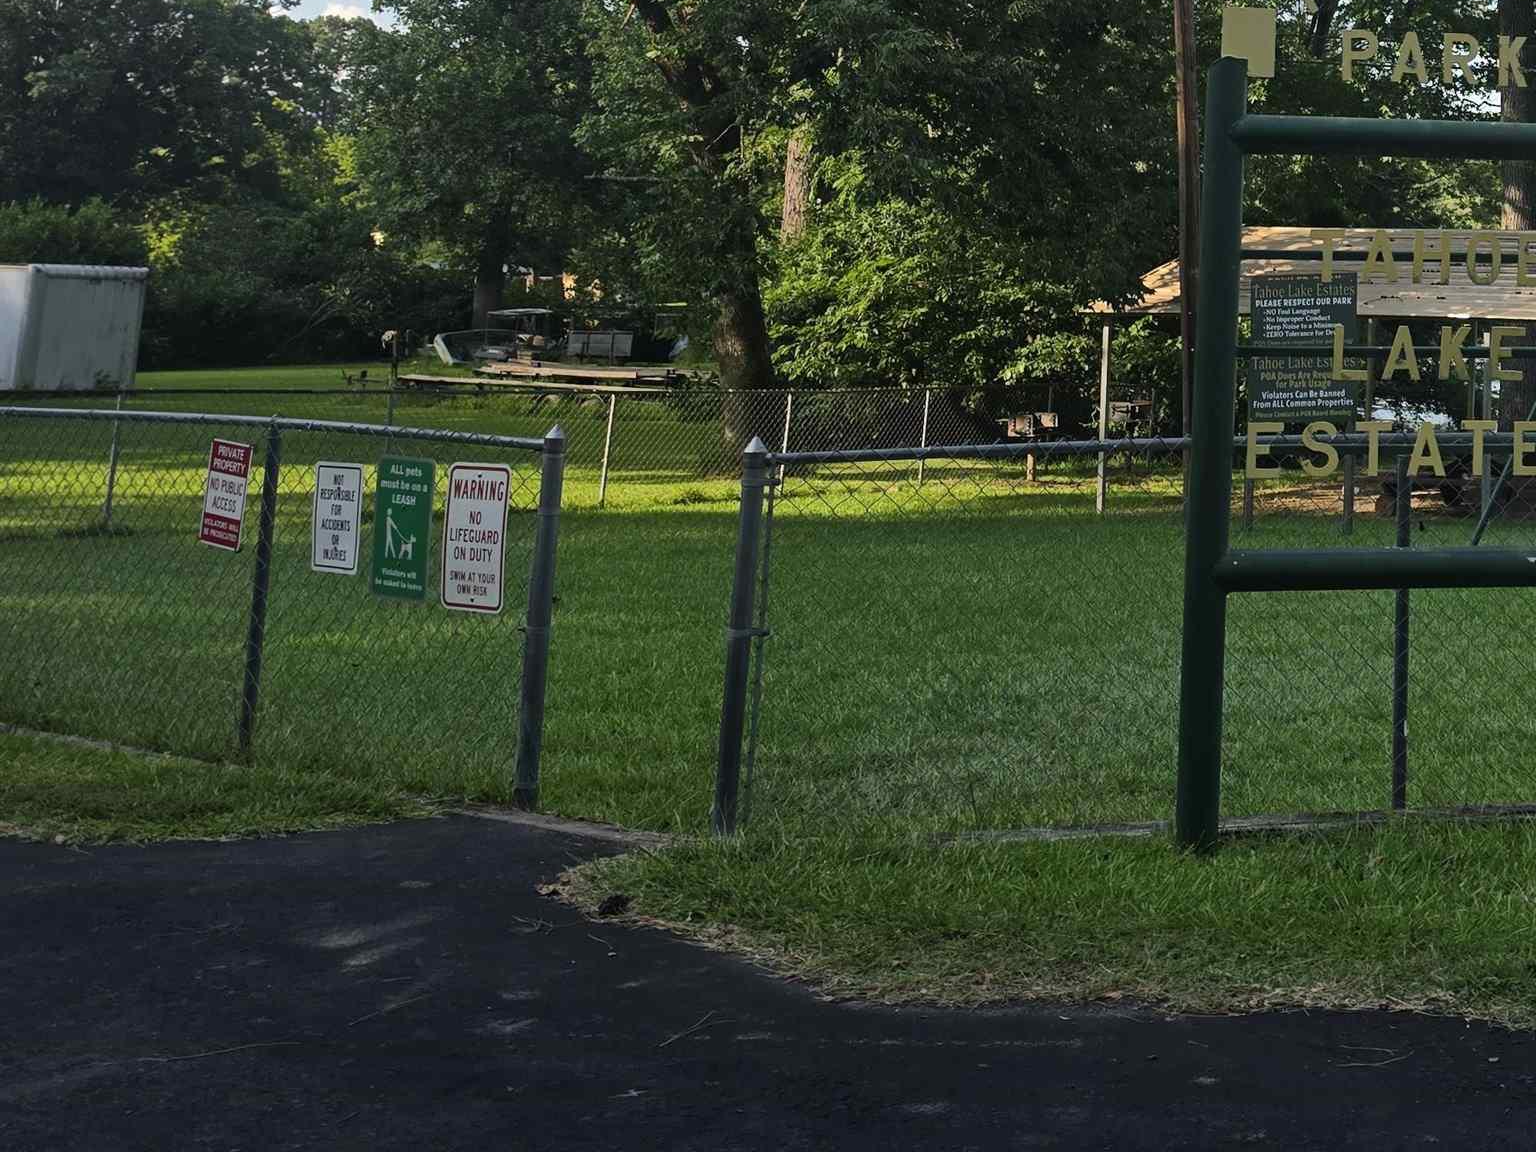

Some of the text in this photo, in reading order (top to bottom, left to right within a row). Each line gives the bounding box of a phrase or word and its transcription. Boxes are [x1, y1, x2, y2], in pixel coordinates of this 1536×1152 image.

[1342, 29, 1528, 88] PARK
[1252, 283, 1355, 298] Tahoe Lake Estates
[1256, 299, 1282, 308] PLEASE
[1284, 298, 1315, 307] RESPECT
[1333, 297, 1353, 305] PARK
[1332, 323, 1526, 381] LAKE
[1251, 356, 1356, 370] Tahoe Lake Estes
[1262, 392, 1294, 400] Violators
[1310, 390, 1318, 398] Be
[1320, 389, 1345, 398] Banned
[1286, 400, 1316, 408] Common
[1318, 399, 1354, 407] Properties
[218, 446, 245, 461] PRIVATE
[213, 458, 246, 475] PROPERTY
[391, 464, 422, 477] ALL pets
[334, 474, 344, 485] NOT
[381, 480, 400, 489] must
[401, 480, 410, 490] be
[211, 477, 243, 496] NO PUBLIC
[454, 480, 505, 501] WARNING
[320, 488, 356, 502] RESPONSIBLE
[392, 494, 416, 505] LEASH
[212, 496, 237, 513] ACCESS
[331, 504, 342, 516] FOR
[321, 518, 351, 531] ACCIDENTS
[469, 512, 481, 525] NO
[332, 535, 339, 545] OR
[450, 528, 499, 545] LIFEGUARD
[323, 549, 346, 561] INJURIES
[454, 546, 493, 562] ON DUTY
[450, 570, 496, 585] SWIM AT YOUR
[457, 584, 487, 596] OWN RISK
